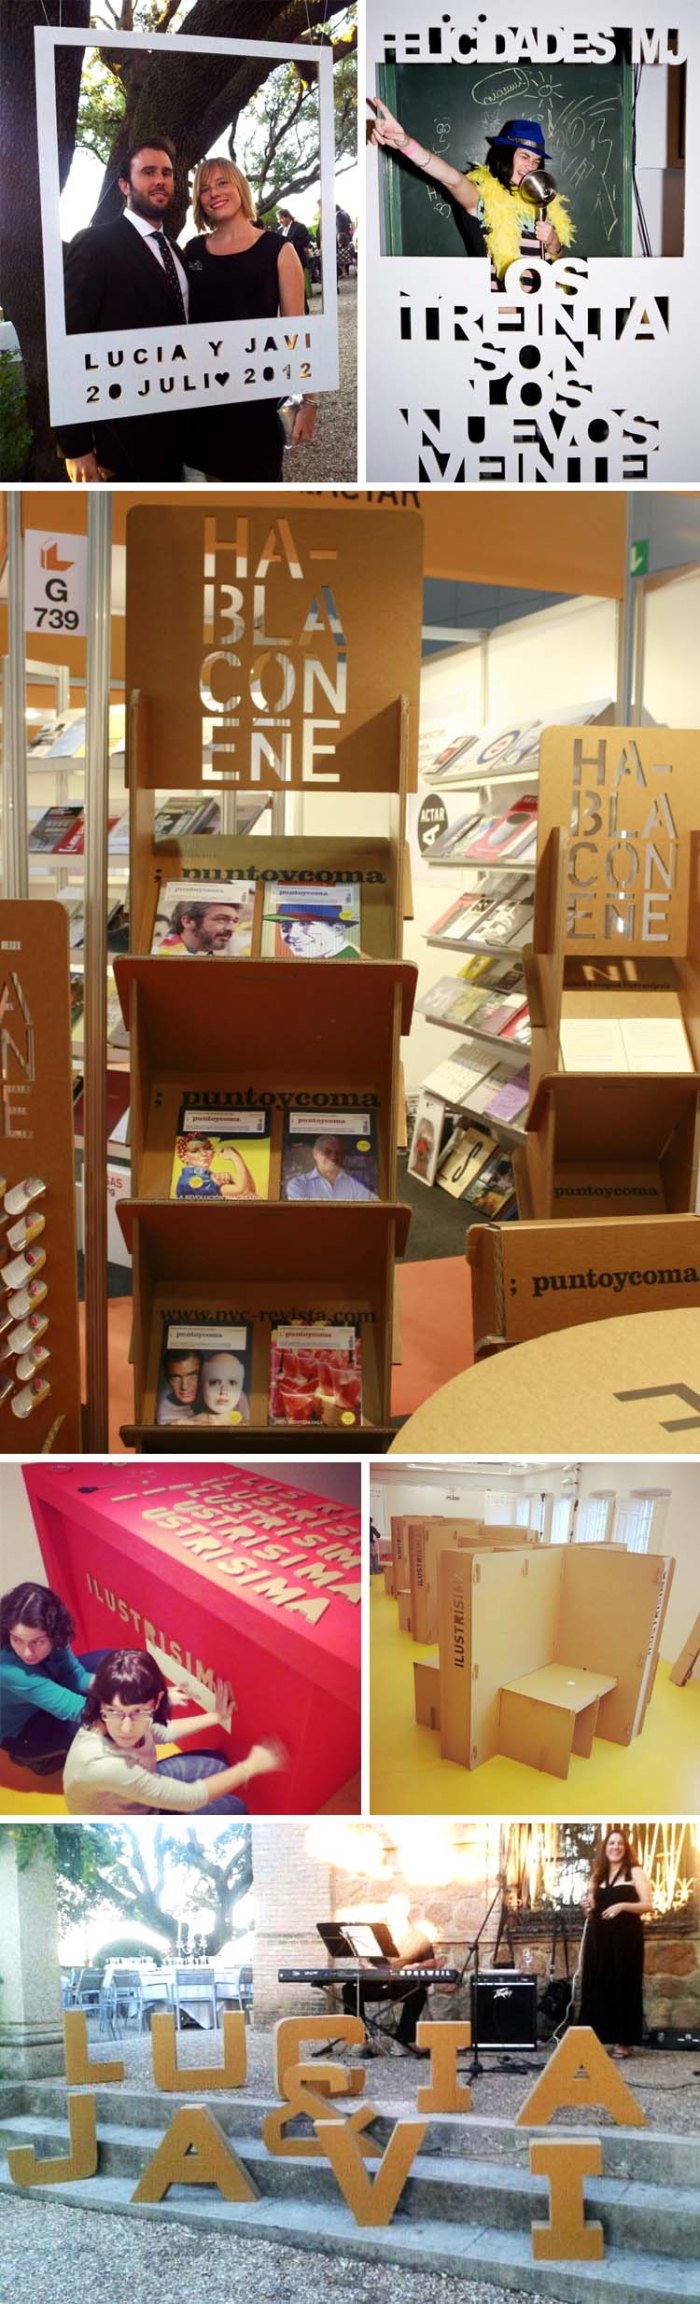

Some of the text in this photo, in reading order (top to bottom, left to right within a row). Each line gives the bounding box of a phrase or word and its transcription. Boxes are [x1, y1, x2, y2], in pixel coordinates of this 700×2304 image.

[632, 27, 688, 65] MJ
[480, 257, 589, 295] LOS
[399, 296, 670, 341] TREINTA
[84, 333, 311, 370] LUCIA Y JAVI
[473, 341, 593, 381] SON
[86, 383, 122, 404] 20
[243, 362, 312, 384] 2012
[476, 378, 593, 410] LOS
[402, 409, 659, 452] NUEVOS
[416, 453, 650, 482] VEINTE
[203, 515, 338, 578] HA-
[45, 578, 68, 602] G
[34, 606, 80, 631] 739
[202, 584, 348, 646] BLA
[199, 651, 348, 714] CON
[201, 716, 341, 783] EÑE
[572, 738, 673, 788] HA-
[420, 807, 446, 822] ACTAR
[570, 789, 679, 839] BLA
[568, 841, 679, 889] CON
[566, 891, 672, 942] EÑE
[553, 1184, 659, 1199] puntoycoma
[532, 1267, 700, 1297] puntoycoma
[7, 2093, 604, 2261] JAVI
